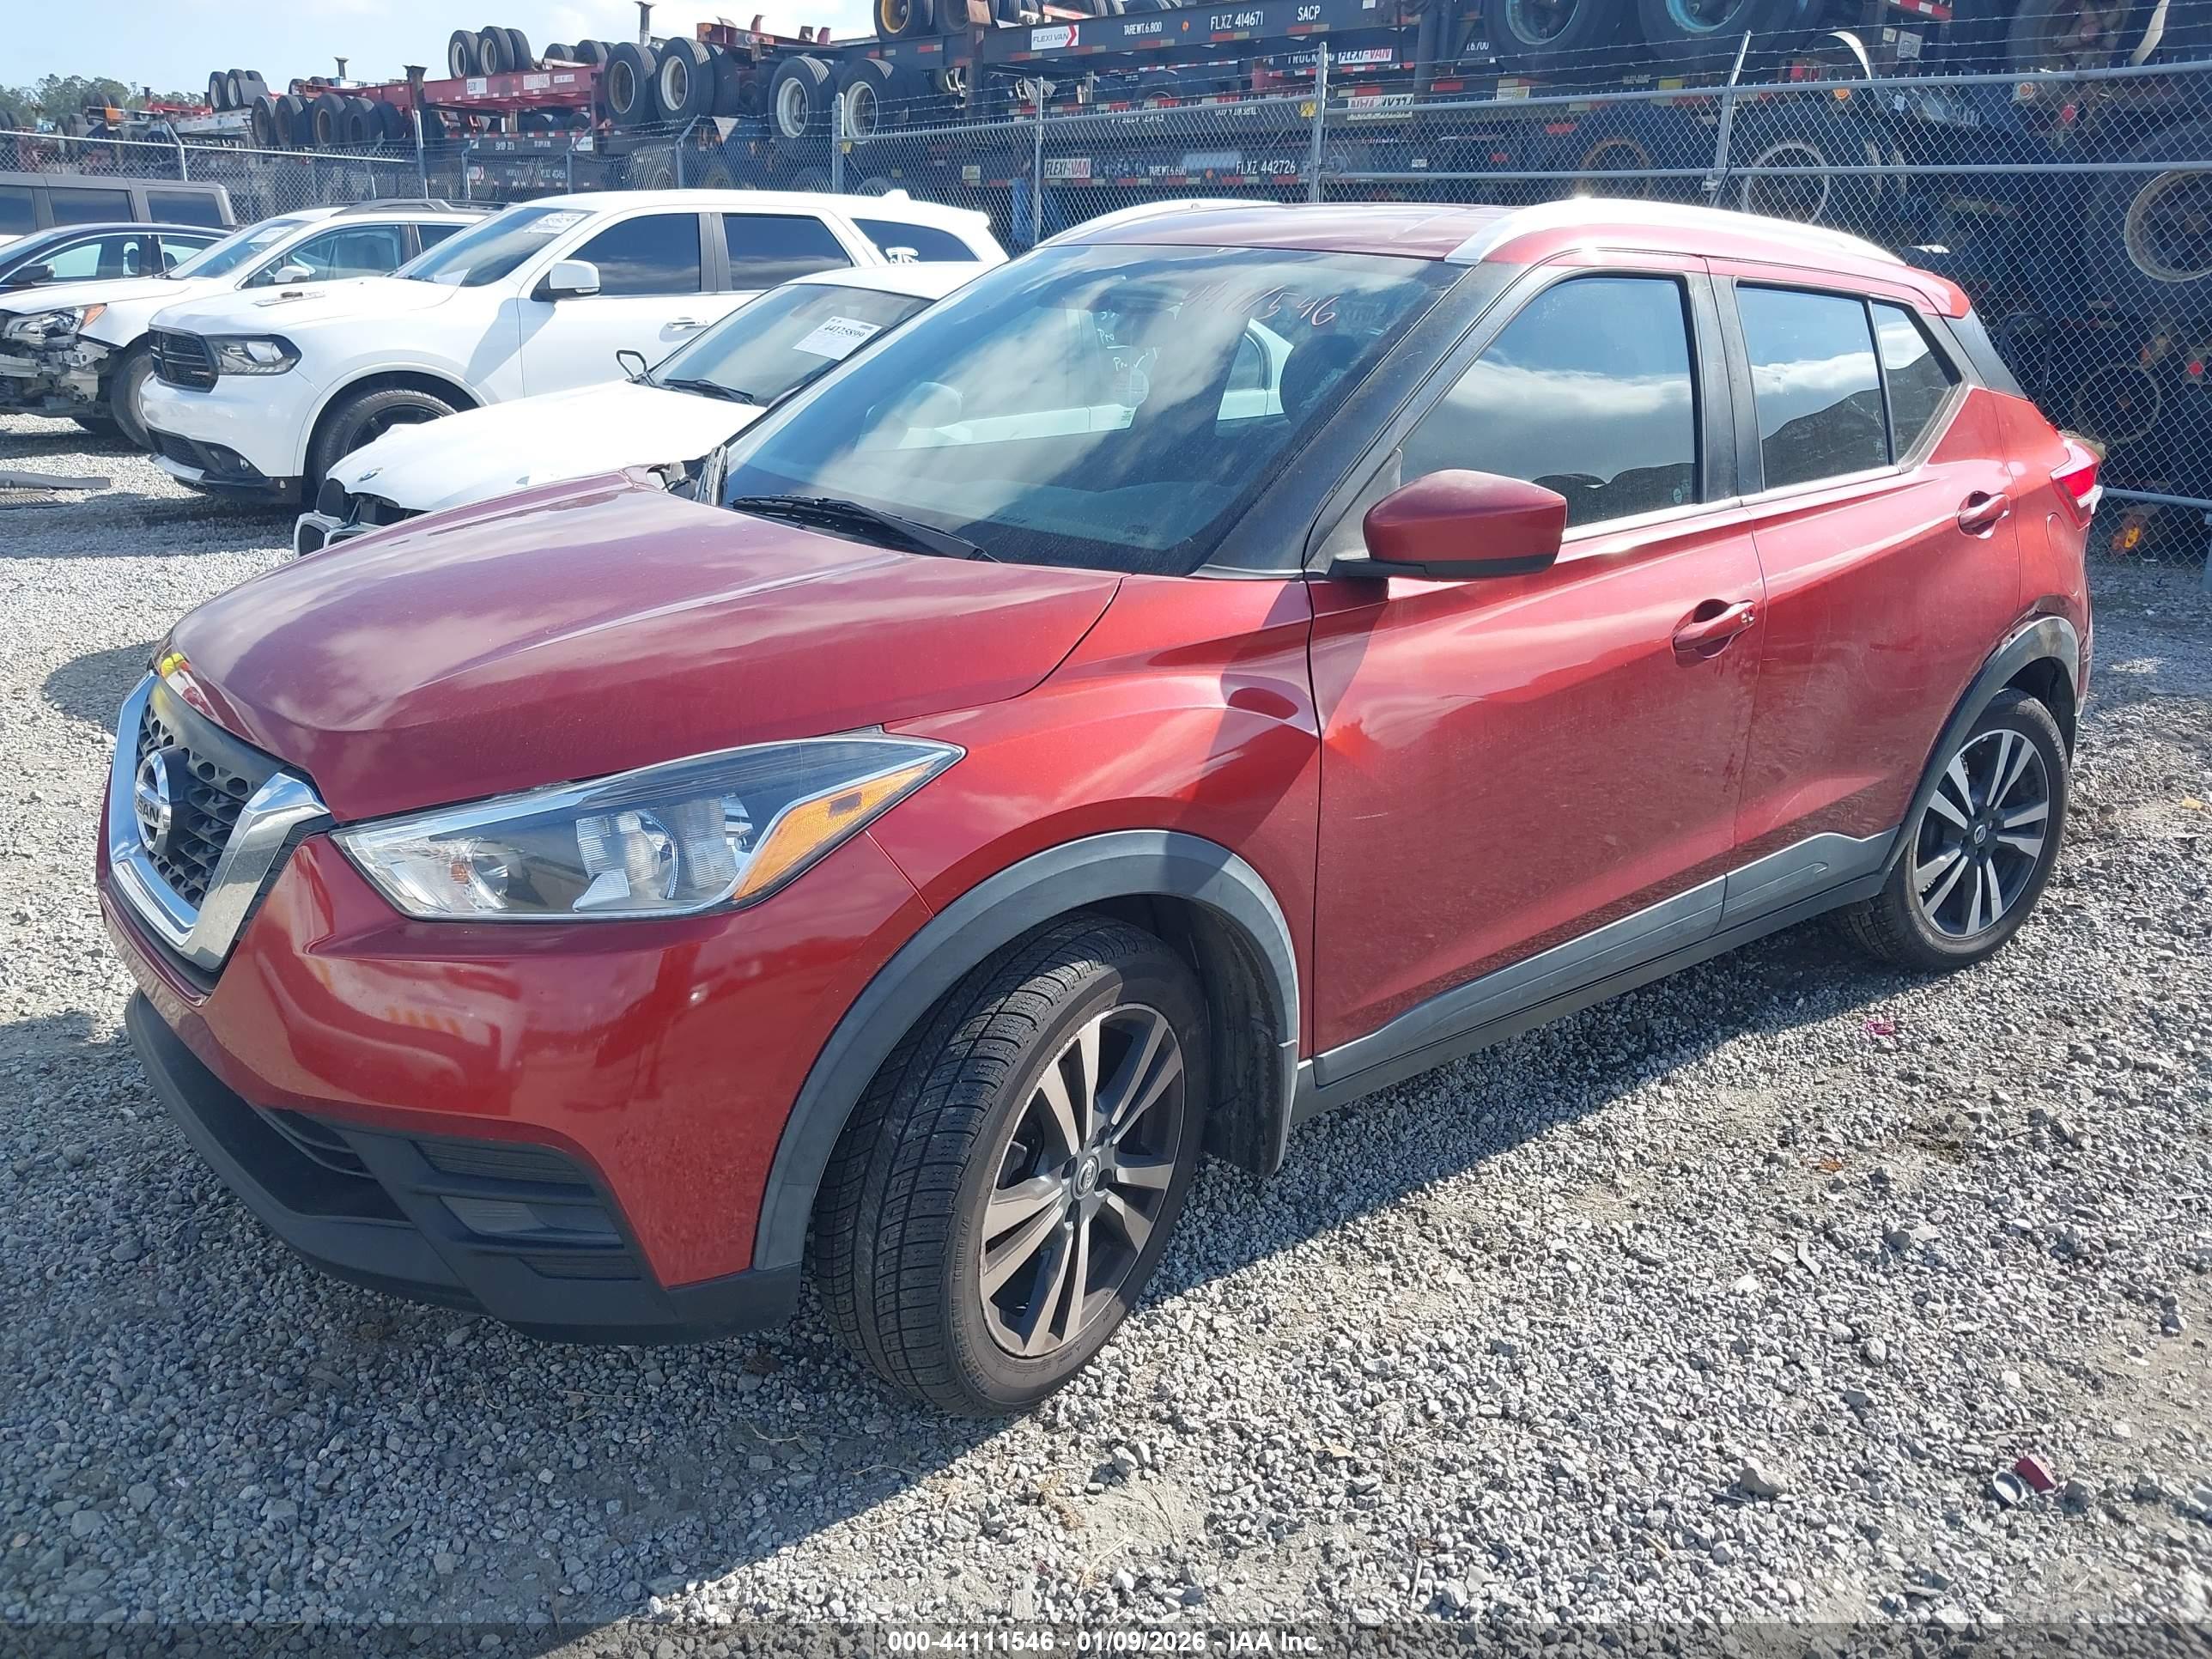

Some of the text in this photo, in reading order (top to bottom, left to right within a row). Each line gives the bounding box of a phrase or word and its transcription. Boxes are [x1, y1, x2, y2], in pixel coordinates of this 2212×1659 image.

[1211, 11, 1263, 30] FLXZ 414671
[1297, 5, 1320, 21] SACP
[1237, 159, 1296, 174] FLXZ 442726
